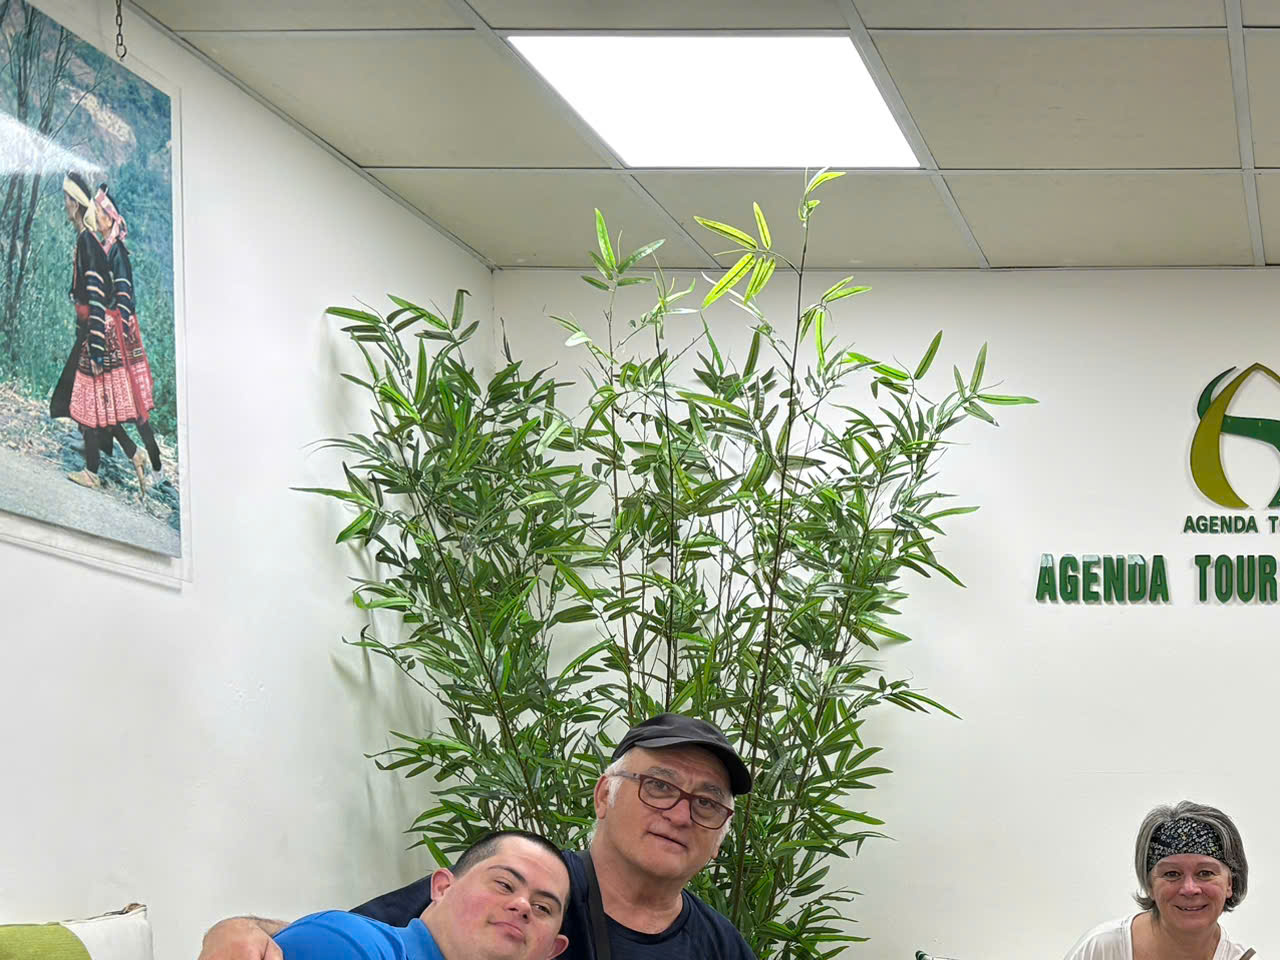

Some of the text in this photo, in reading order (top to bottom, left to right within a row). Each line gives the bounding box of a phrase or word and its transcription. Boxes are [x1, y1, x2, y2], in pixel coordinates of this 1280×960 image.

[1183, 515, 1258, 534] AGENDA
[1035, 553, 1170, 604] AGENDA
[1194, 554, 1279, 604] TOUR
